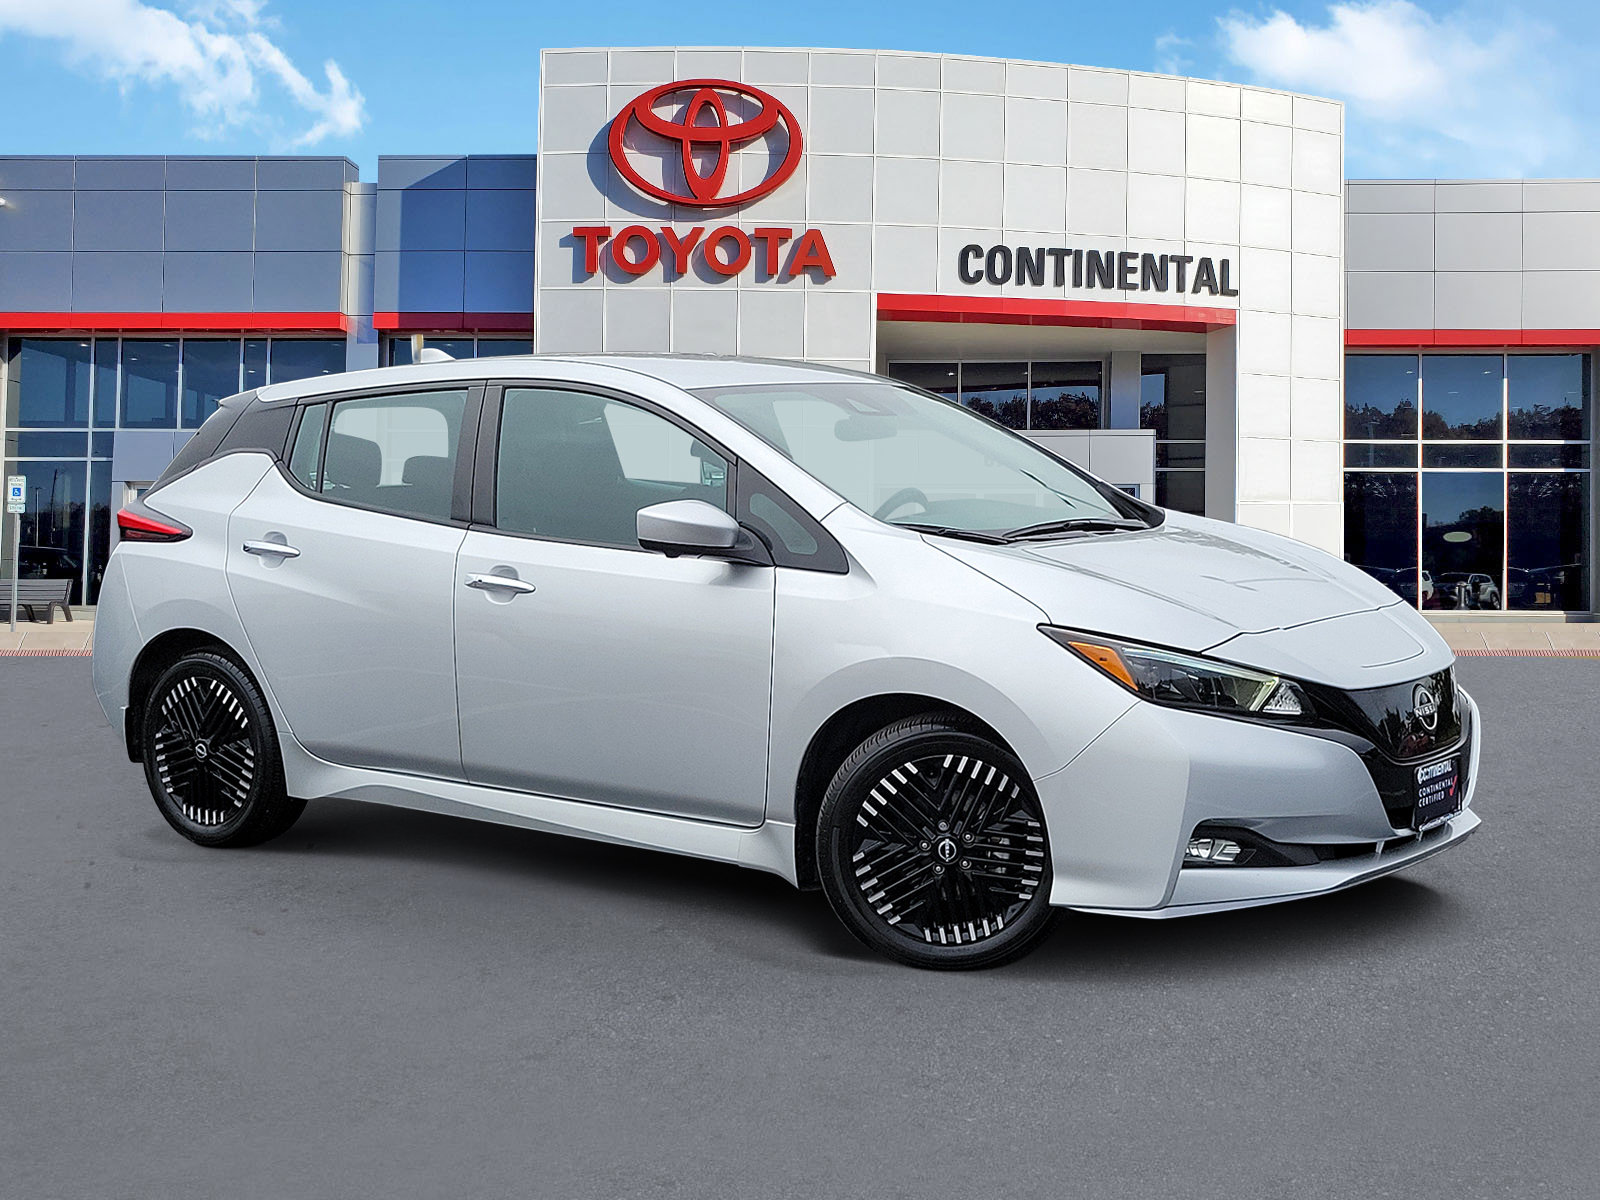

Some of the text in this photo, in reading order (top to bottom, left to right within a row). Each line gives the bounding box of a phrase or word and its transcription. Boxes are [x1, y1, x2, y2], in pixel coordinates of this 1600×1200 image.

[573, 225, 836, 276] TOYOTA
[958, 244, 1239, 296] CONTINENTAL
[1414, 704, 1435, 718] NISS
[1419, 777, 1453, 797] CONTINENTAL
[1419, 791, 1445, 807] CERTIFIED
